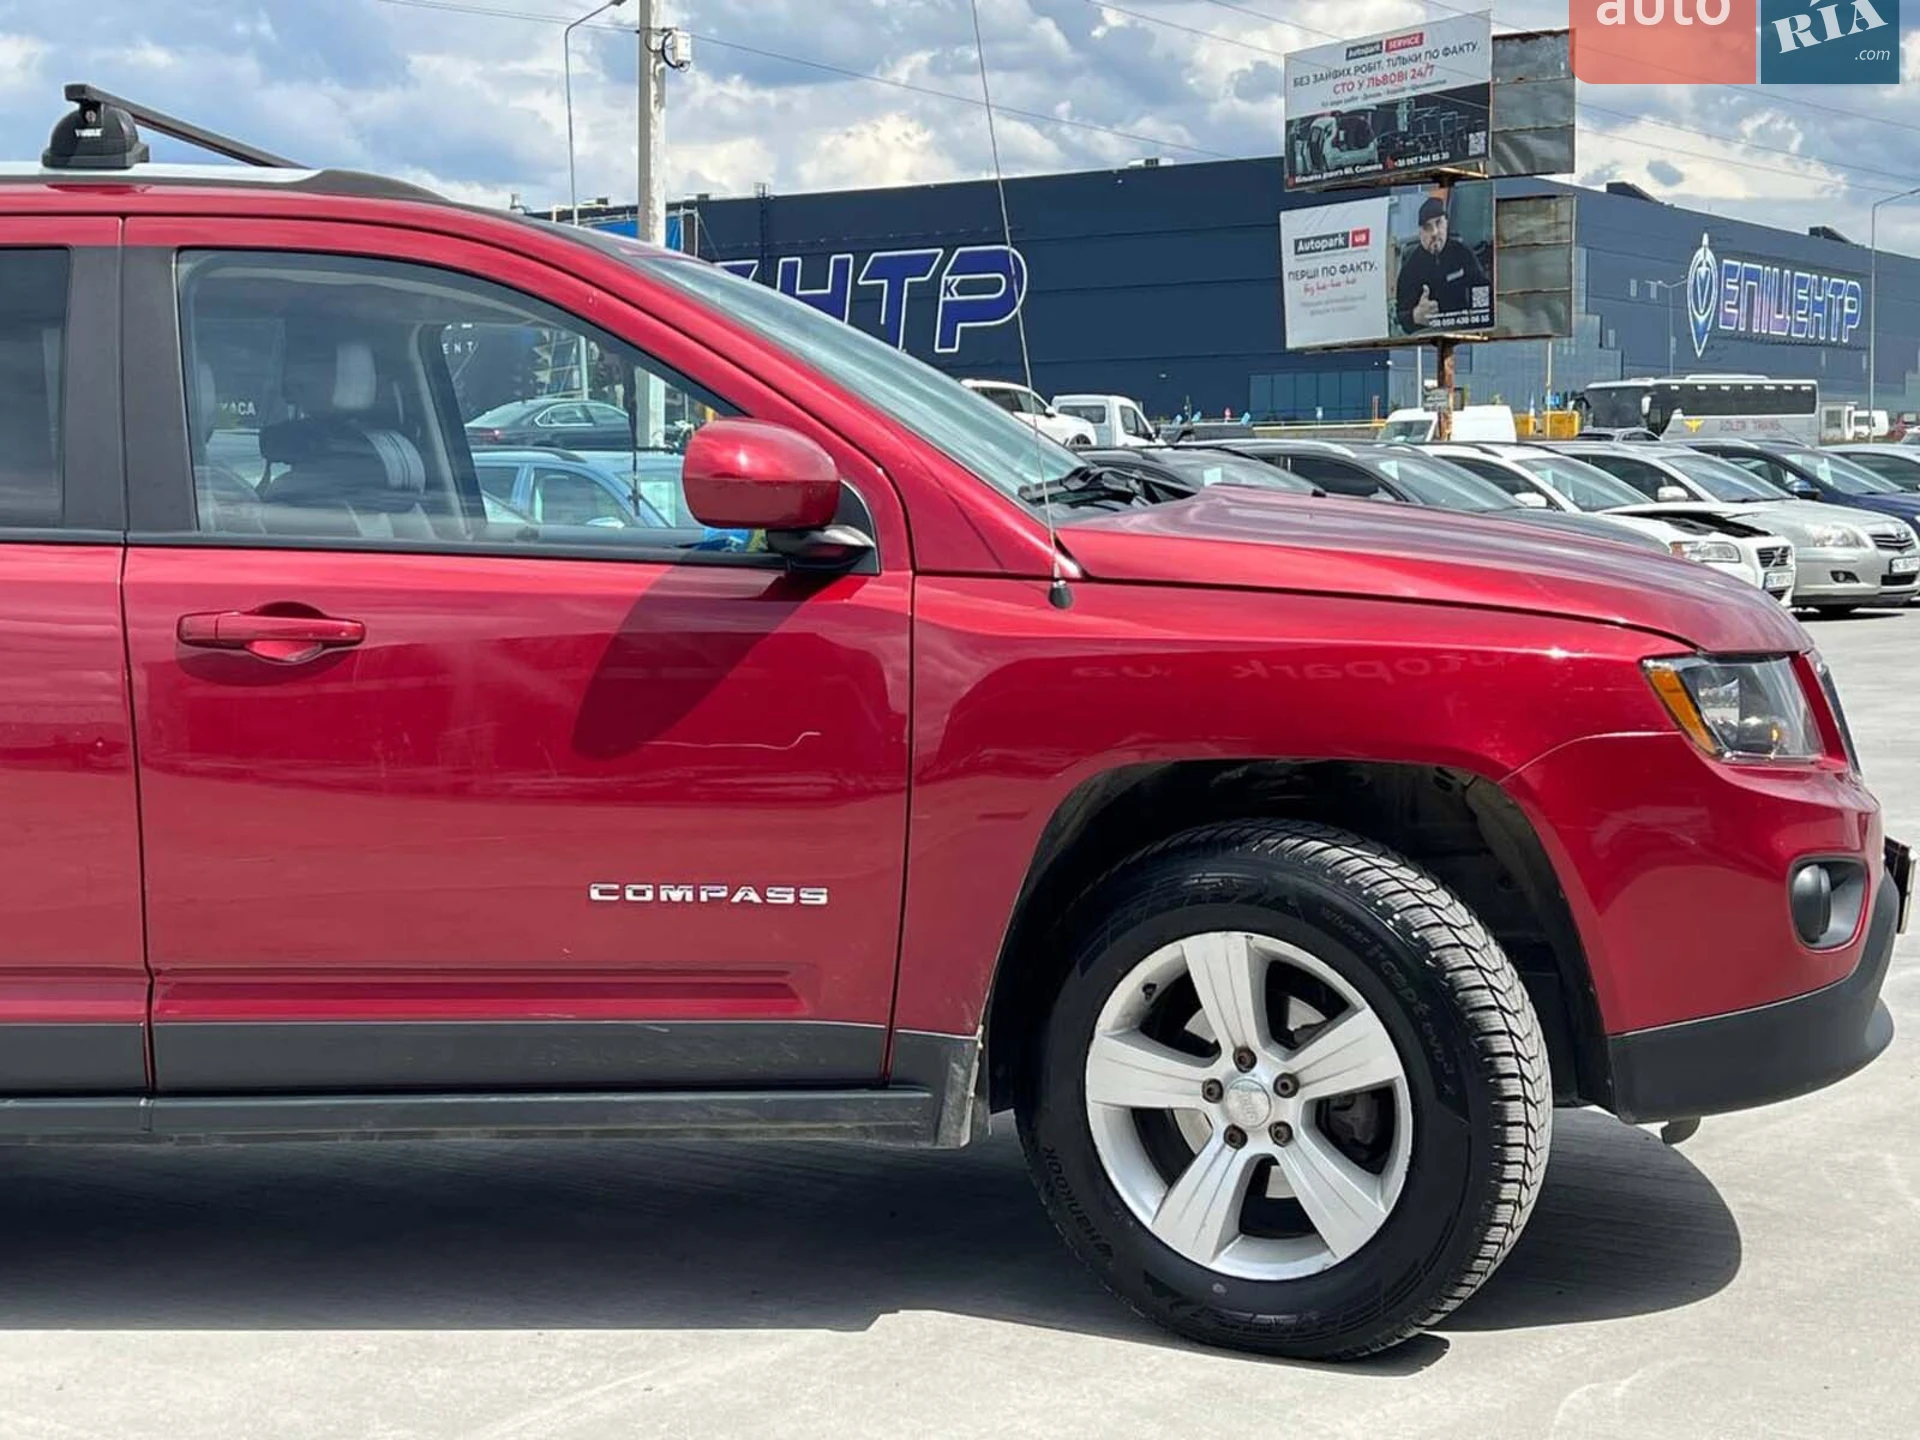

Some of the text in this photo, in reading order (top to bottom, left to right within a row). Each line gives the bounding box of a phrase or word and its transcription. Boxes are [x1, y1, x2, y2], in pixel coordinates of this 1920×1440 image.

[1387, 35, 1421, 50] SERVICE
[1293, 76, 1311, 88] БЕЗ
[1386, 54, 1422, 68] ТІЛЬКИ
[1424, 49, 1440, 61] ПО
[1333, 81, 1355, 96] СТО
[1357, 79, 1366, 91] У
[1366, 69, 1408, 89] ЛЬВОВІ
[1410, 64, 1435, 80] 24/7
[1297, 233, 1345, 252] Autopark
[1288, 260, 1378, 281] ПЕРШІ ПО ФАКТУ.
[712, 244, 1028, 354] НТР
[1718, 258, 1863, 343] ЕПІЦЕНТР
[589, 882, 829, 906] COMPASS
